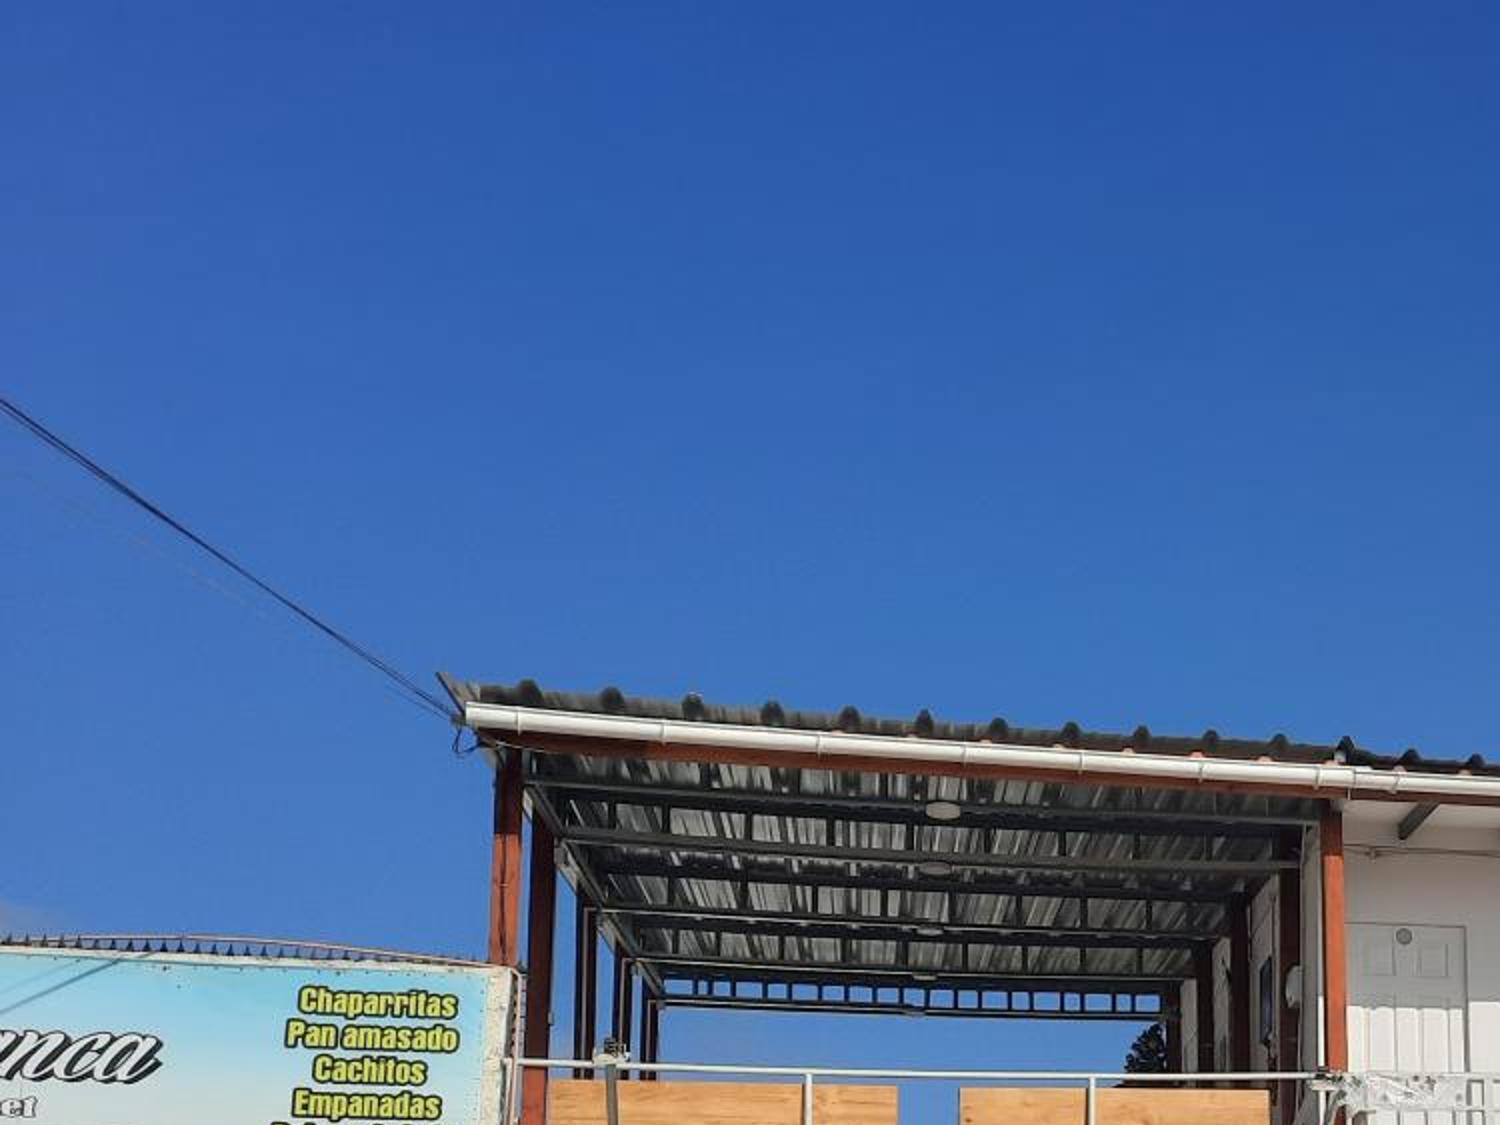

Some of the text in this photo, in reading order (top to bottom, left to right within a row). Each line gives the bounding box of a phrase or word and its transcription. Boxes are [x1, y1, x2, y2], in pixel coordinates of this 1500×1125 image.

[298, 986, 459, 1020] Chaparritas
[285, 1018, 460, 1053] Pan amasado
[312, 1054, 428, 1086] Cachitos
[293, 1088, 443, 1122] Empanadas
